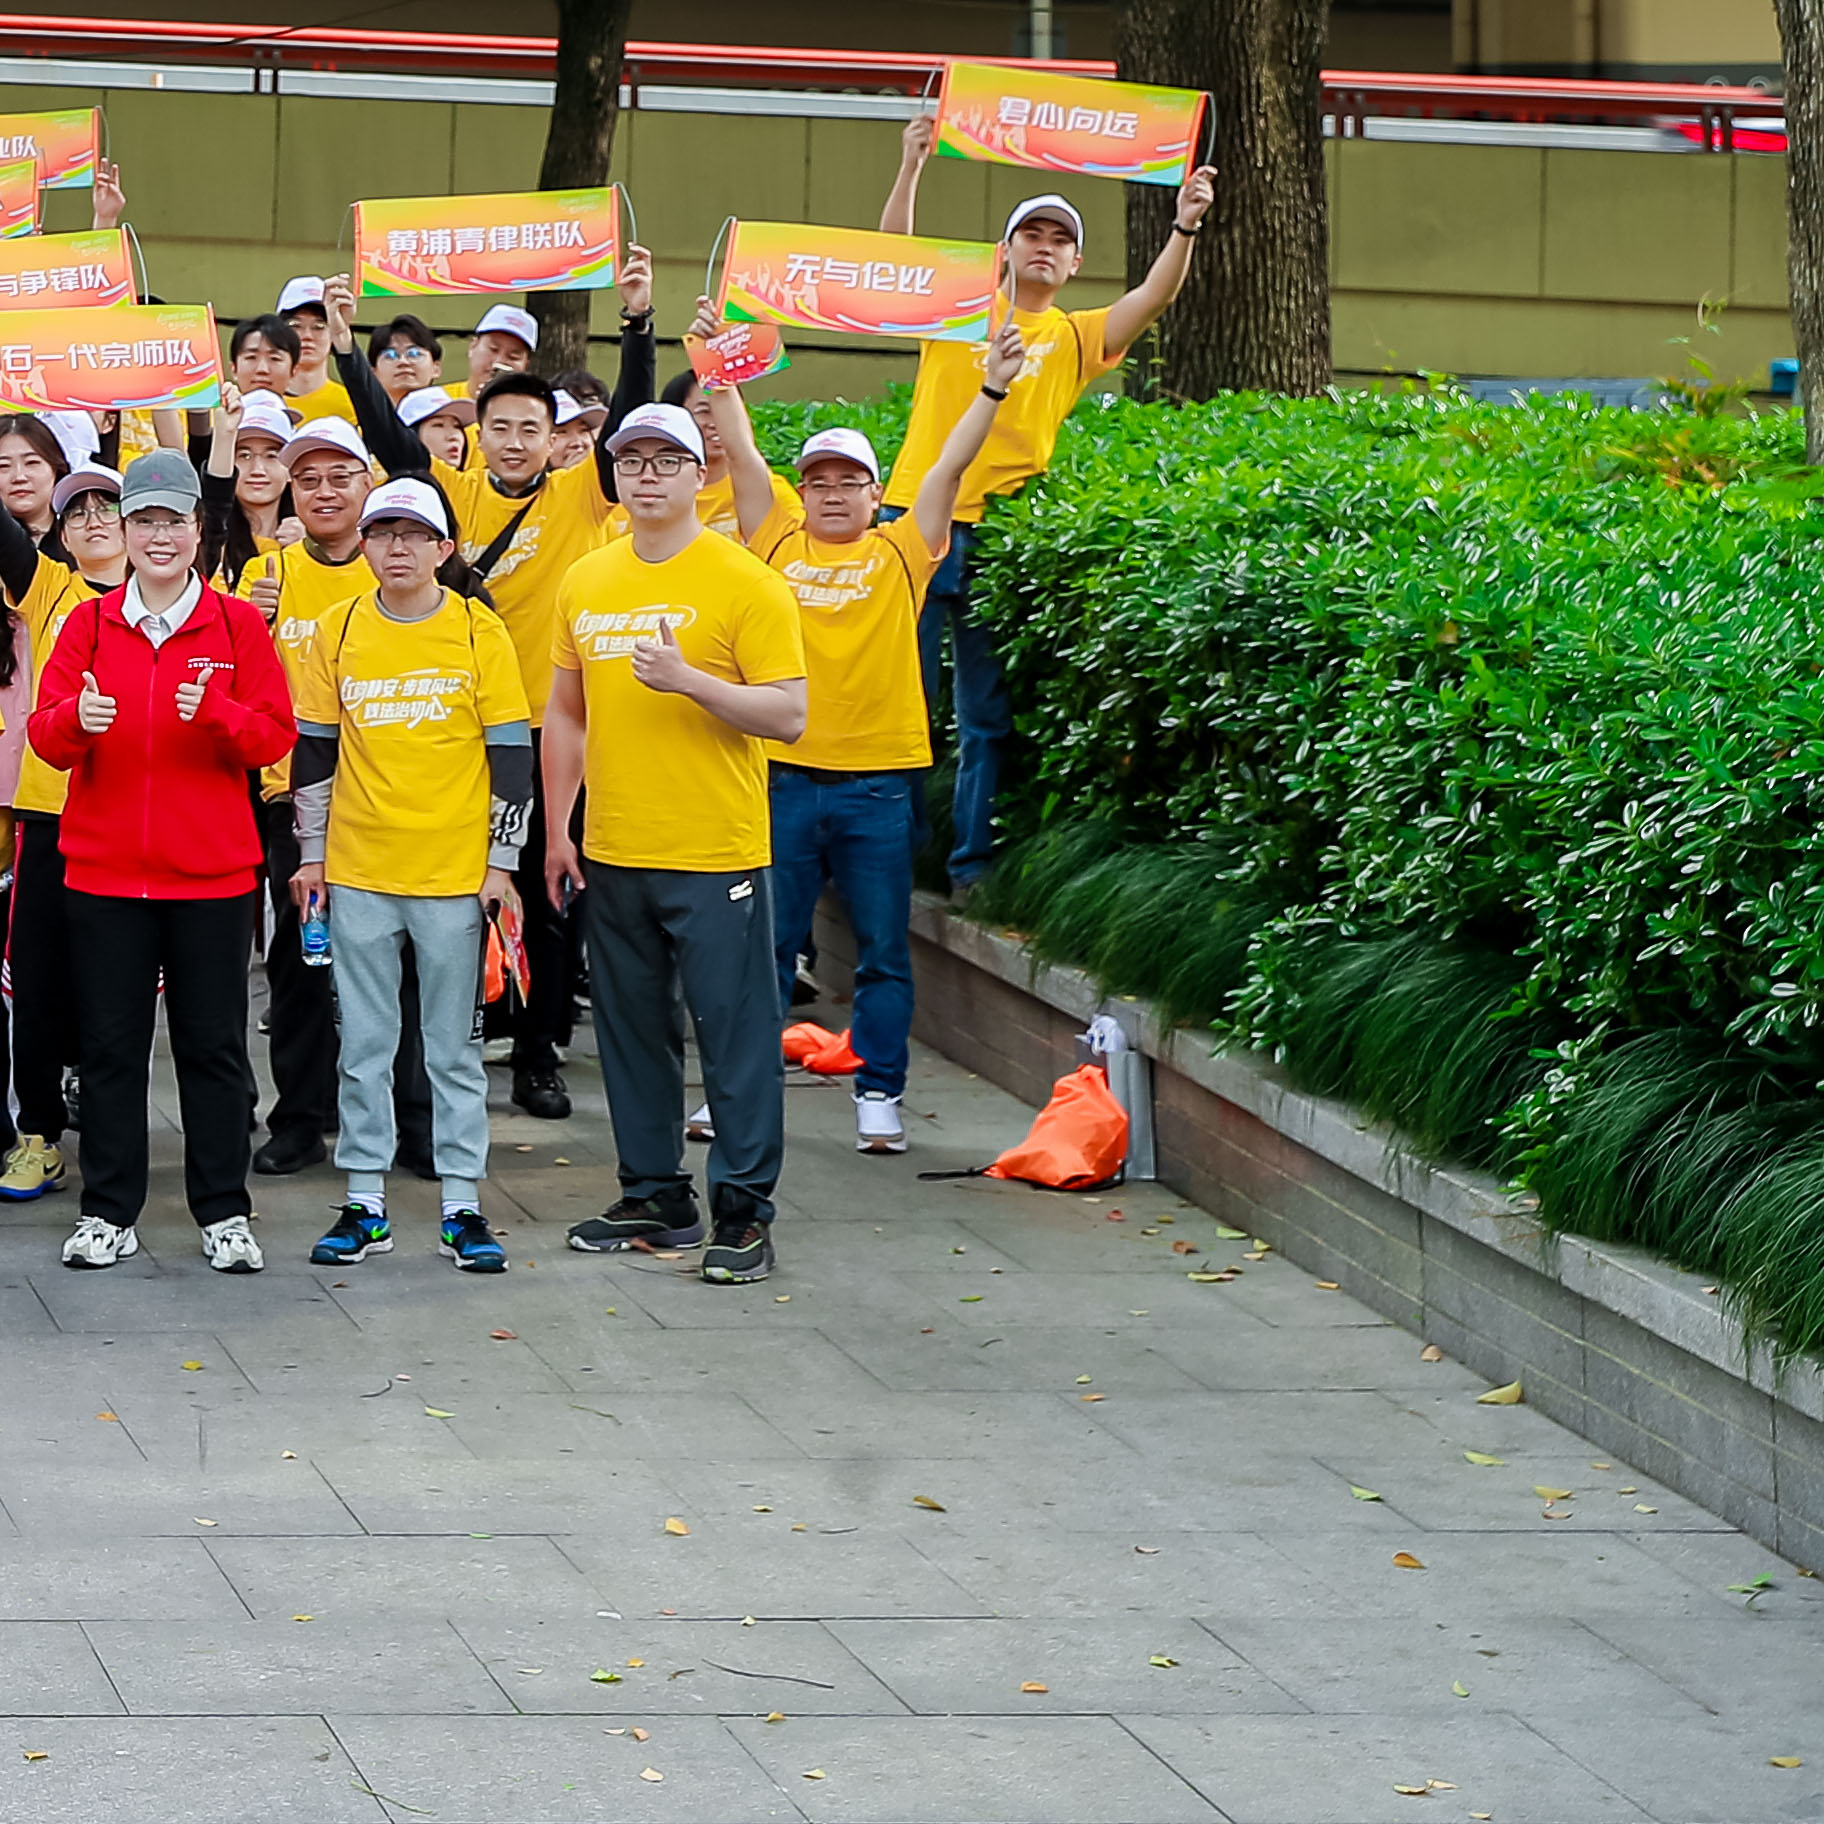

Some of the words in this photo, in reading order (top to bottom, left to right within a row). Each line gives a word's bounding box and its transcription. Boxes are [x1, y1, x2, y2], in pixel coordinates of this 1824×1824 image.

[998, 95, 1139, 139] 君心向远
[387, 221, 587, 257] 黄浦青律联队
[785, 254, 935, 295] 无与伦比
